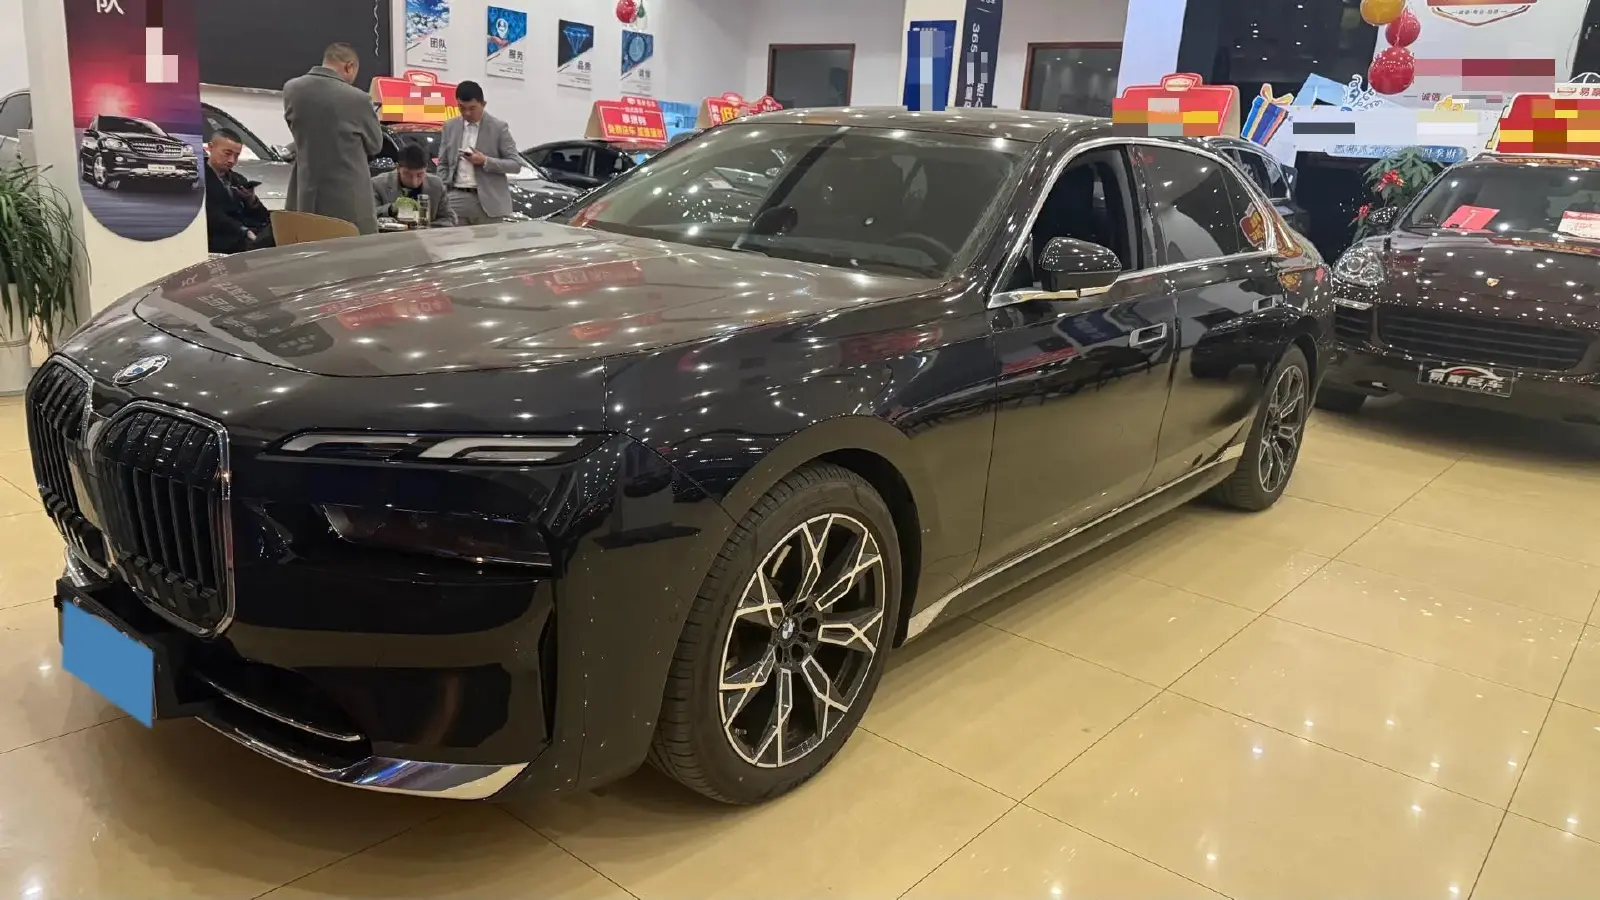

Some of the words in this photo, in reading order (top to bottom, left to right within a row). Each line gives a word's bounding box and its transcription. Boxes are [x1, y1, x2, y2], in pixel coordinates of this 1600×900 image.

[430, 37, 447, 50] 团队
[970, 22, 980, 53] 365
[508, 49, 524, 61] 服务
[1420, 92, 1442, 102] 诚信
